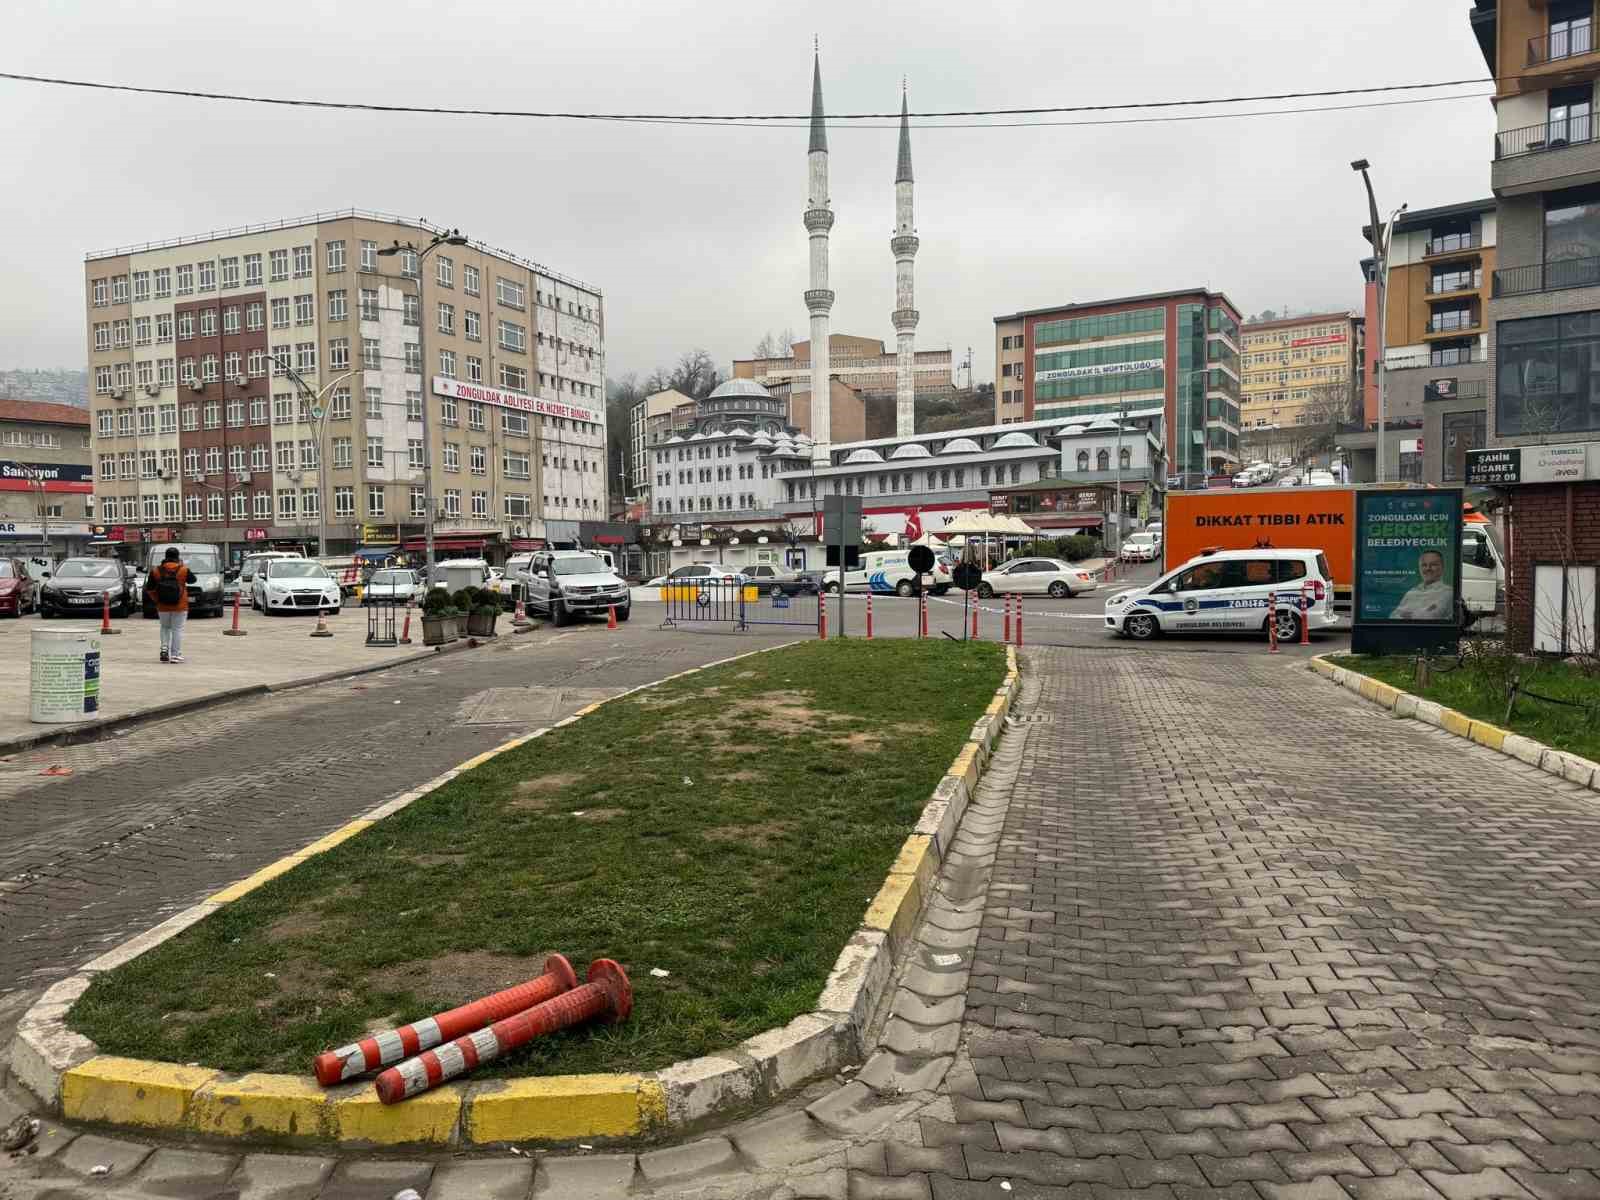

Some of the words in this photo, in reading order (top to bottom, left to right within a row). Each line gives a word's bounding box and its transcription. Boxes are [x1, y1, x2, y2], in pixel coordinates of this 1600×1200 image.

[456, 384, 501, 403] ZONGULDAK
[536, 401, 545, 412] EK
[1306, 513, 1345, 525] ATIK
[1367, 513, 1426, 522] ZONGULDAK
[1229, 599, 1265, 608] ZABITA
